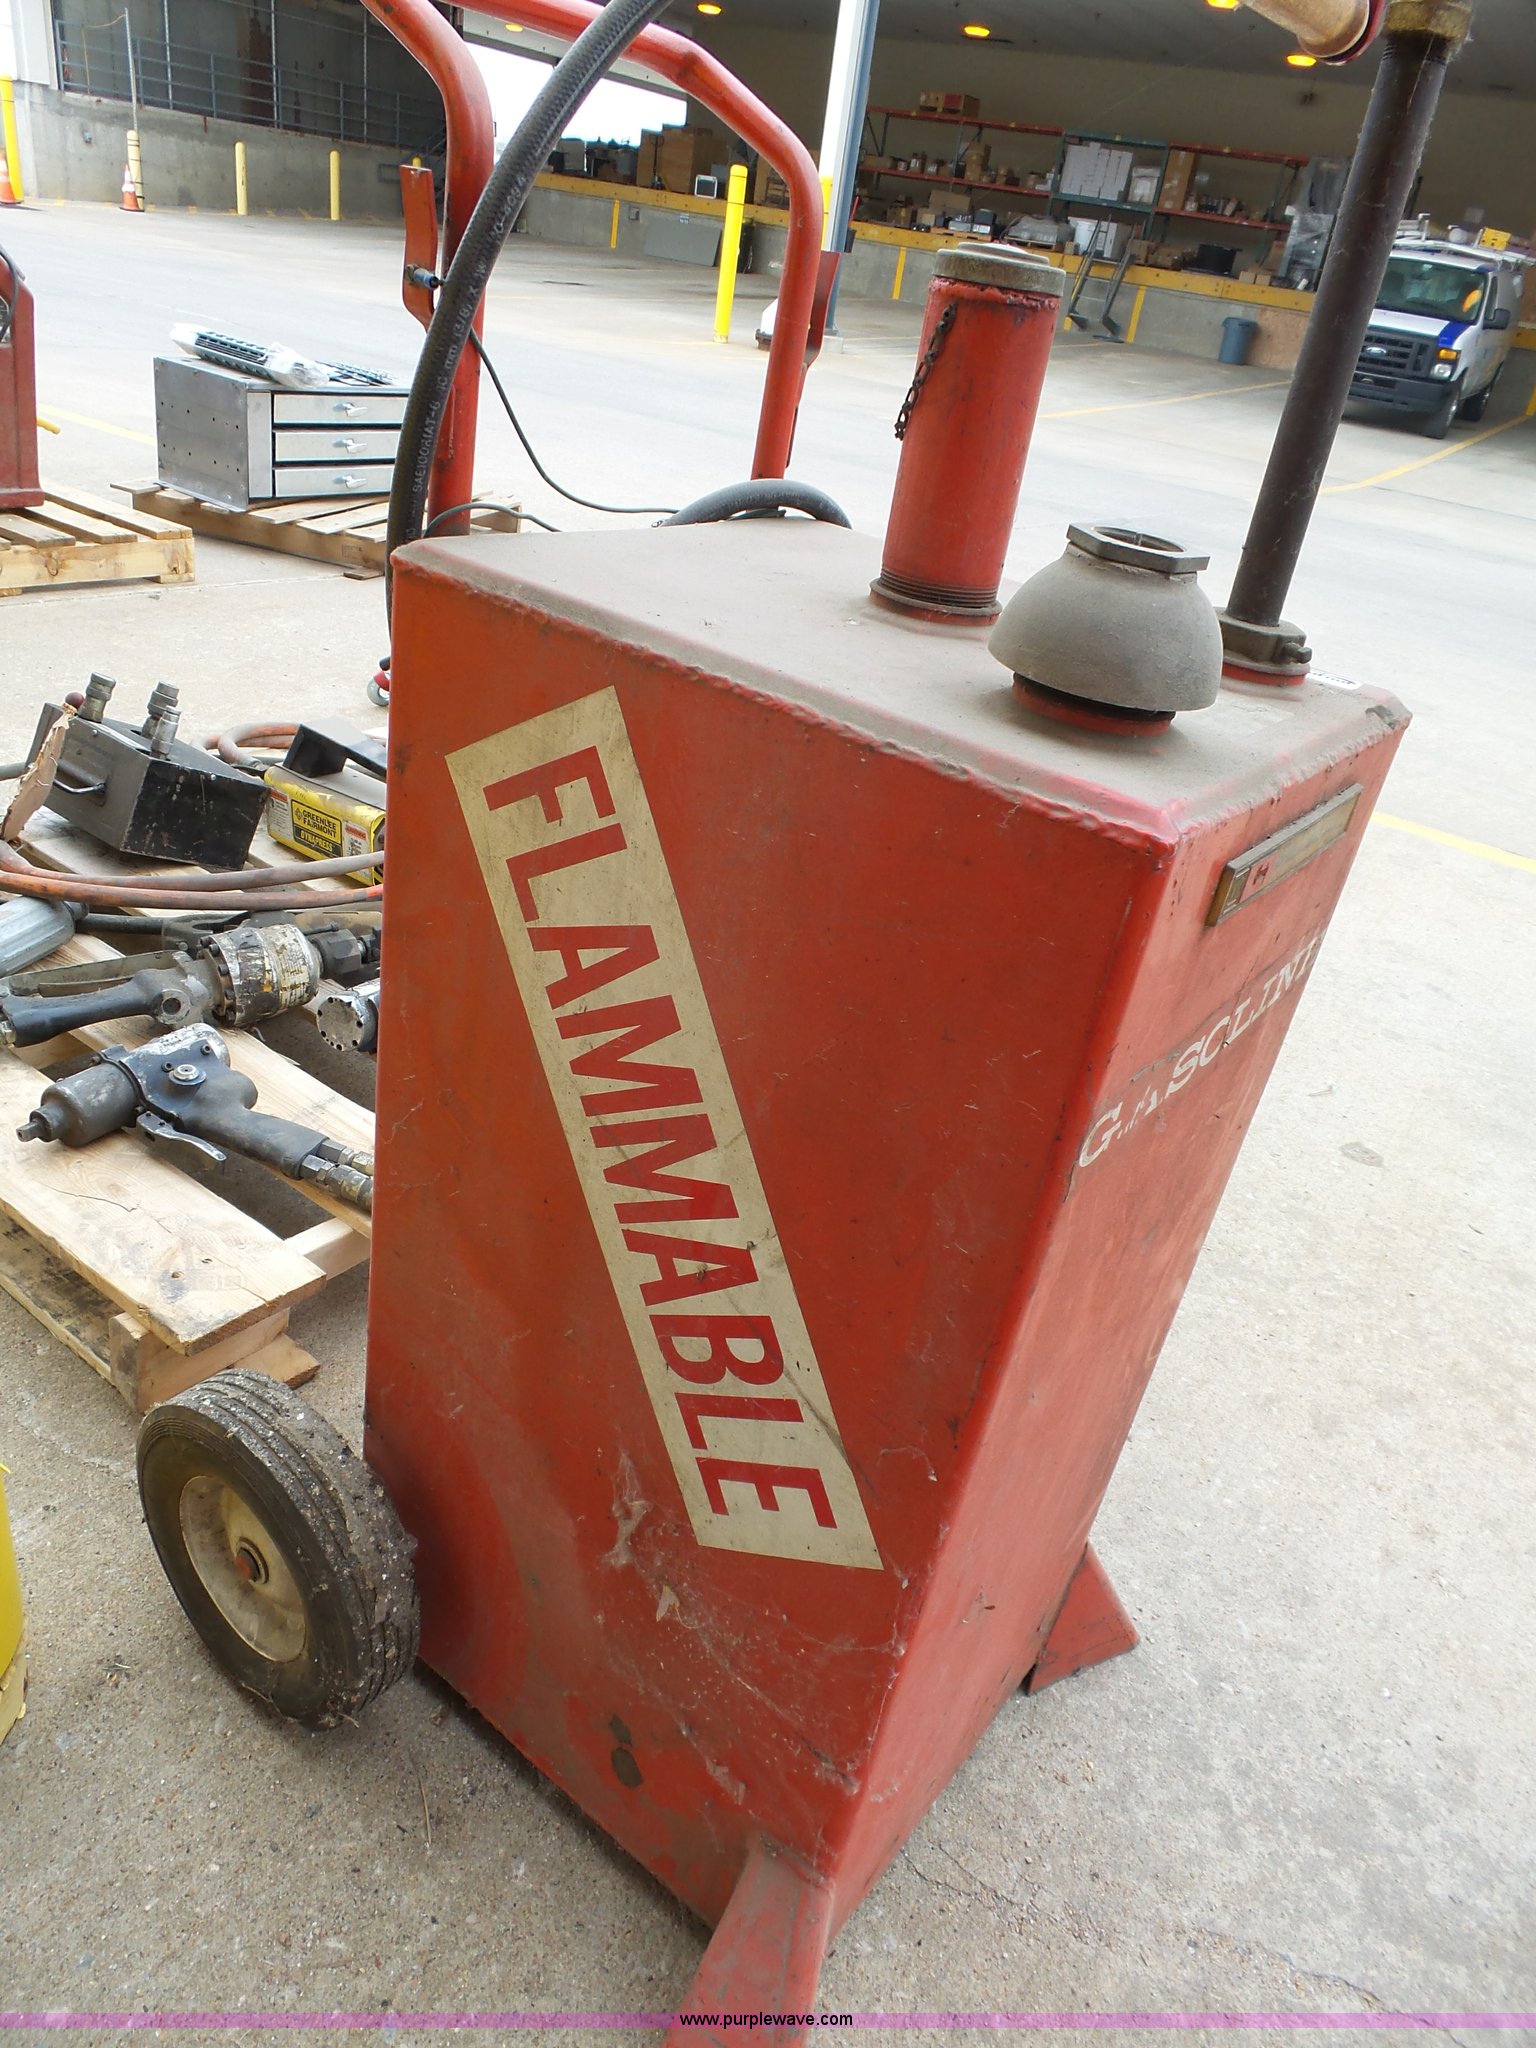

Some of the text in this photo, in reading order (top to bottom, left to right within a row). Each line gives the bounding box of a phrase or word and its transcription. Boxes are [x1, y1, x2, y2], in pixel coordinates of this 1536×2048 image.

[302, 809, 337, 829] GREENLEE
[303, 818, 337, 838] FAIRMONT
[483, 745, 839, 1530] FLAMMABLE
